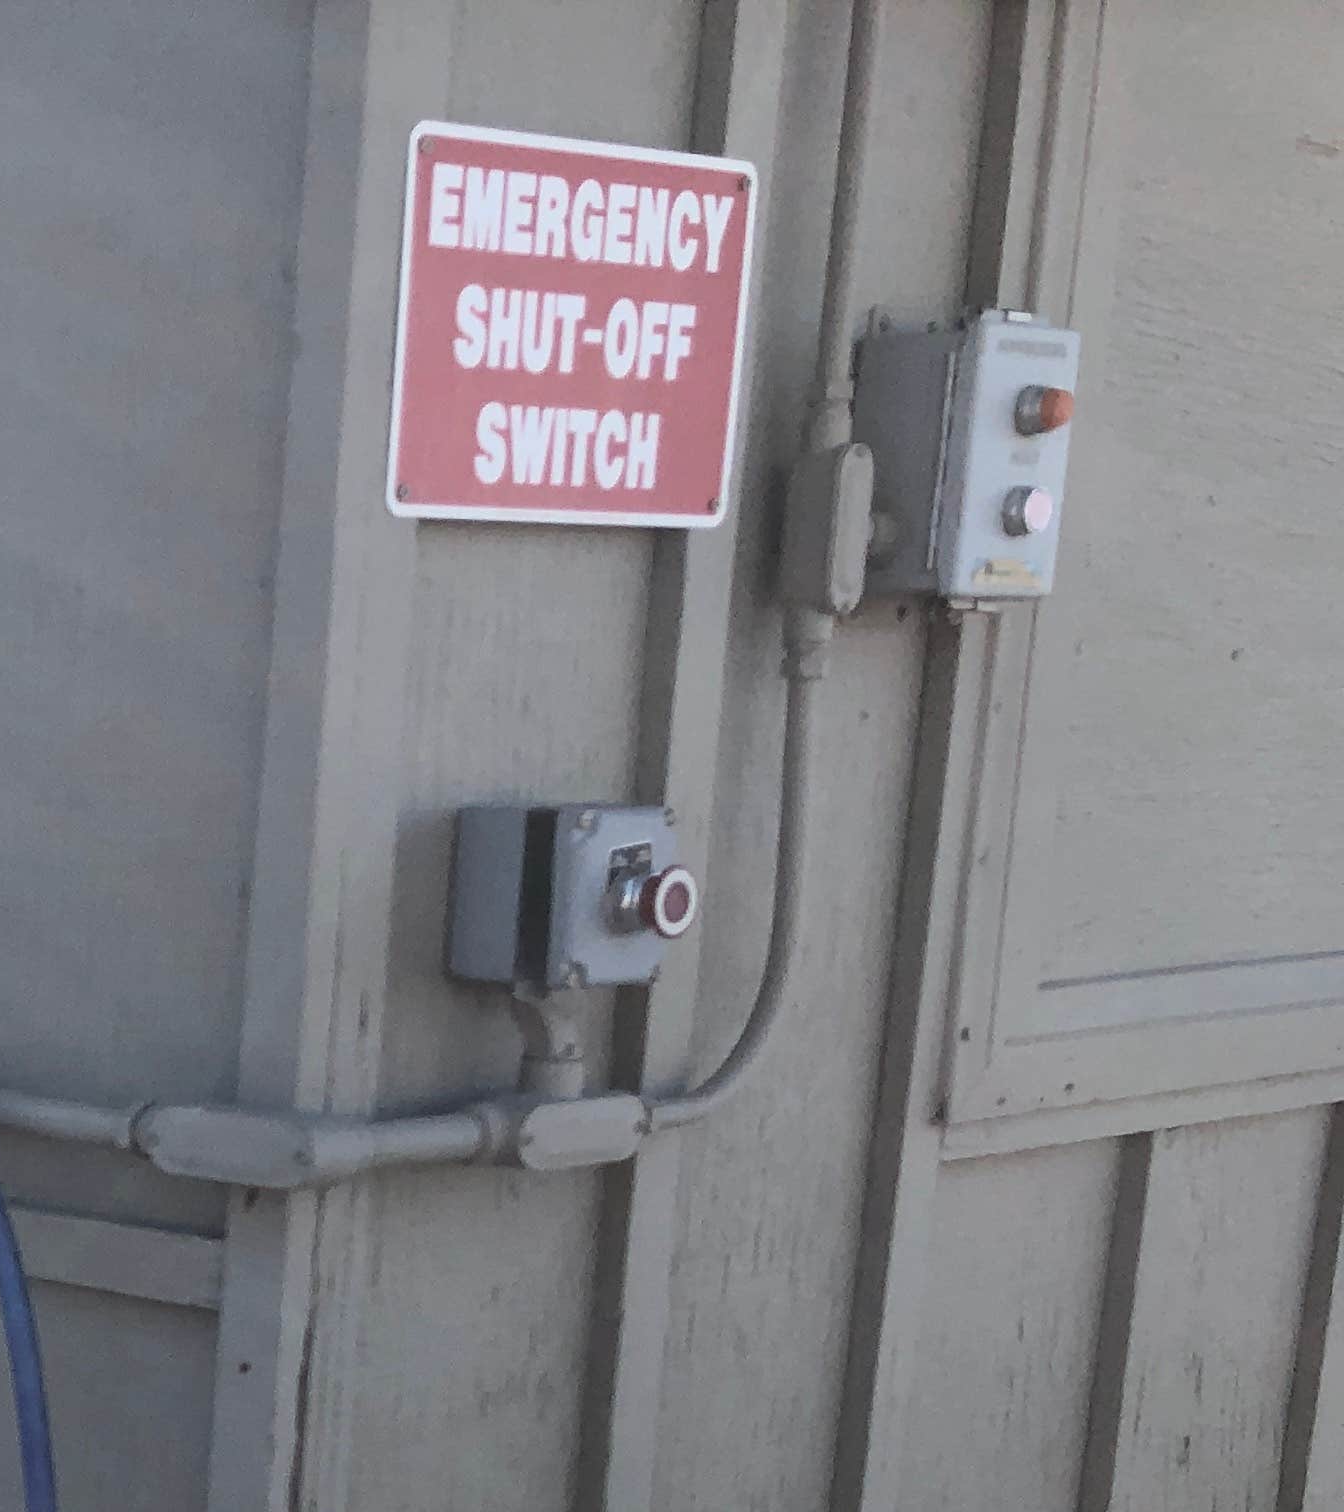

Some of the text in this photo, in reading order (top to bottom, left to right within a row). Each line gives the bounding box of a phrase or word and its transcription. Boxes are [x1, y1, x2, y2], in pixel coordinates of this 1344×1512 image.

[428, 162, 734, 273] EMERGENCY
[452, 284, 697, 382] SHUT-OFF
[474, 401, 662, 491] SWITCH
